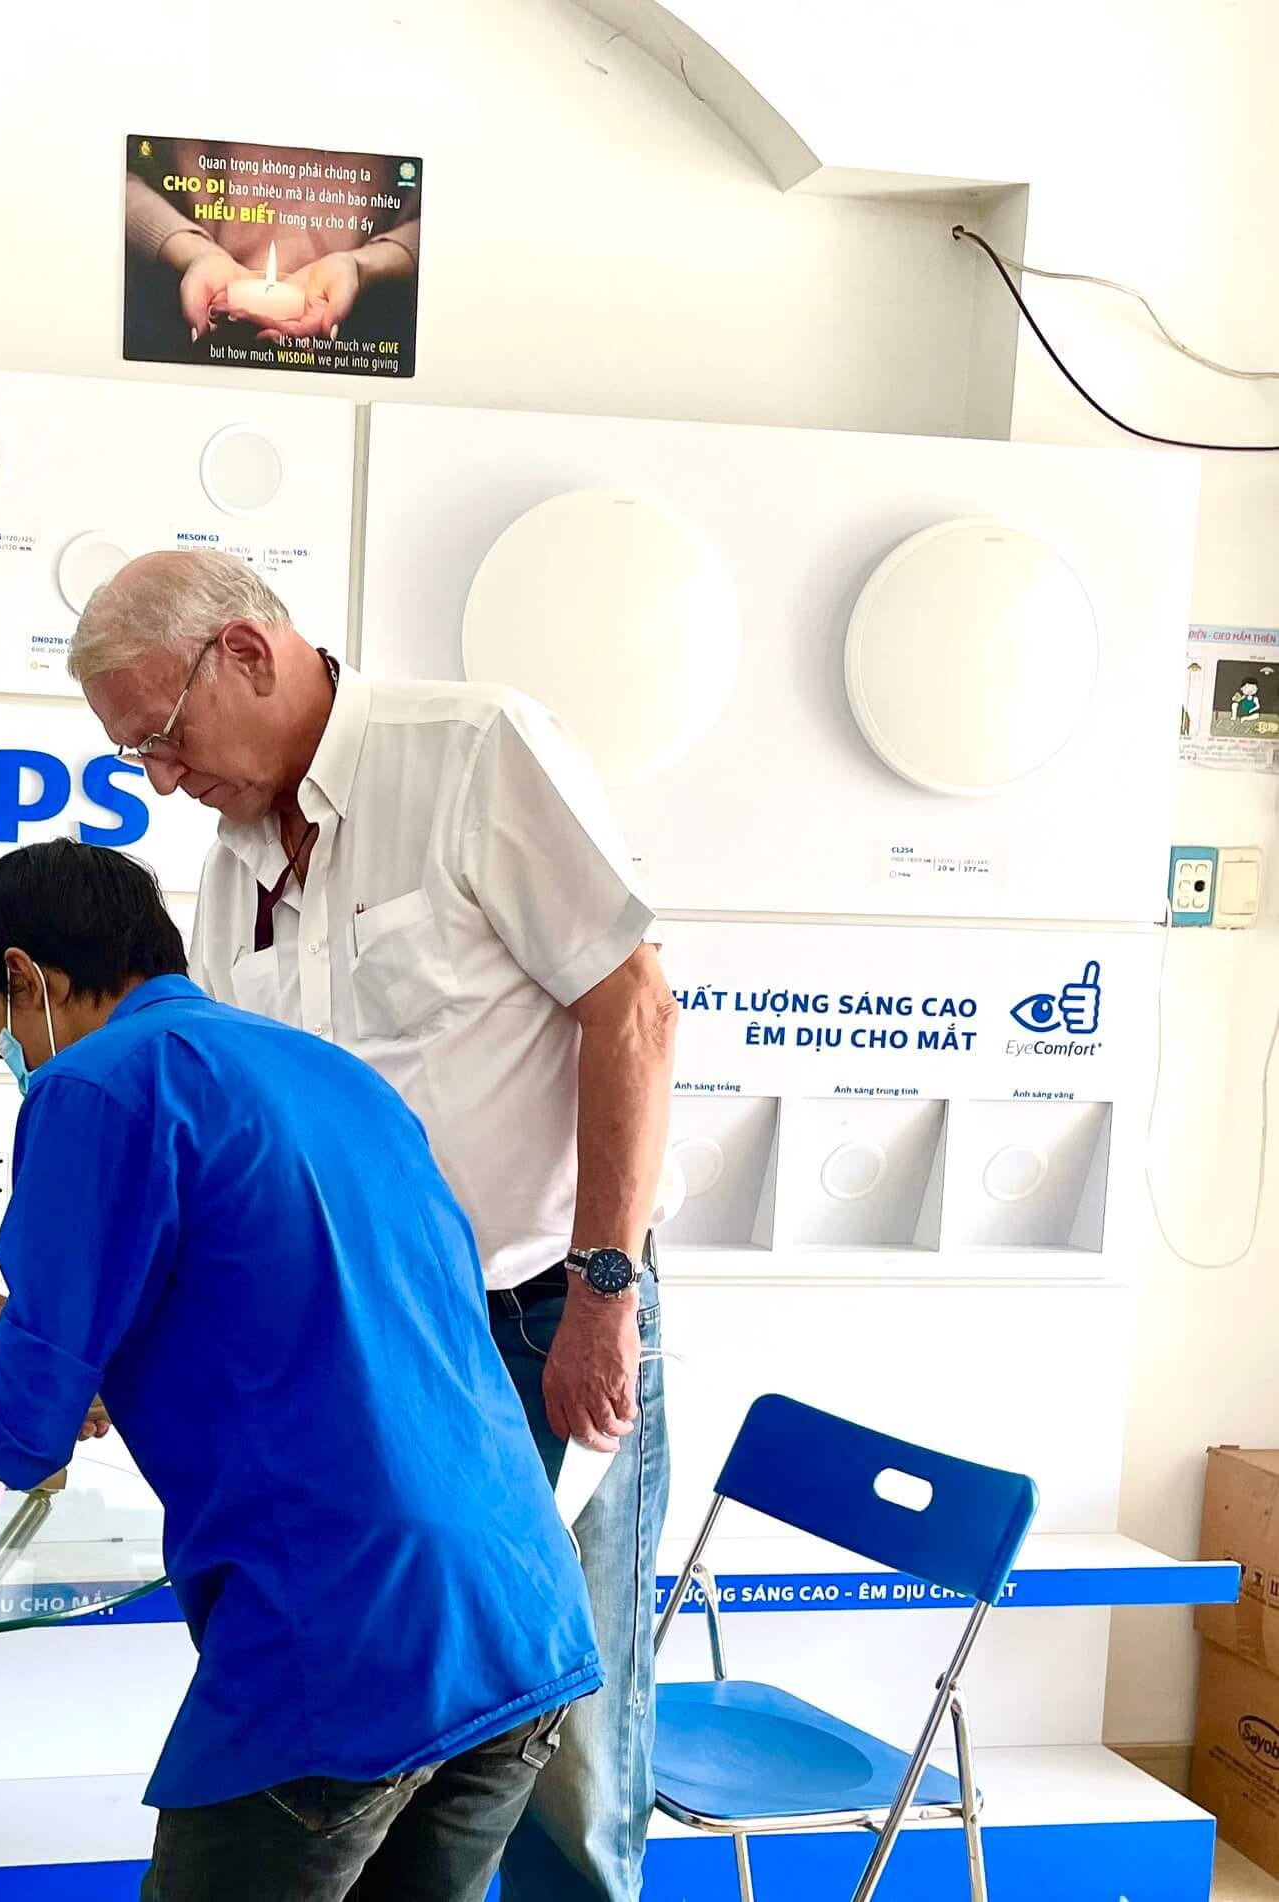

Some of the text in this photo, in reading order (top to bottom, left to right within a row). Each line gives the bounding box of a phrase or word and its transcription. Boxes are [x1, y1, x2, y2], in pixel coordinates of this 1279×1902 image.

[199, 155, 371, 183] Quan trọng không phải chúng ta
[163, 176, 401, 209] CHO ĐI bao nhiêu mà là dành bao nhiêu
[195, 198, 235, 220] HIỂU
[240, 202, 275, 224] BIẾT
[279, 212, 306, 230] trong
[310, 214, 322, 229] sự
[325, 213, 344, 228] cho
[348, 214, 358, 229] đi
[279, 336, 398, 354] It's not how much we GIVE
[210, 344, 398, 372] but how much WISDOM we put into giving
[177, 533, 219, 542] MESON G3
[671, 983, 978, 1018] HẤT LƯỢNG SÁNG CAO
[745, 1021, 978, 1053] ÊM DỊU CHO MẮT
[1006, 1038, 1097, 1057] EyeComfort
[876, 1087, 899, 1096] trung
[741, 1584, 795, 1602] SÁNG
[799, 1586, 839, 1601] CAO
[859, 1582, 887, 1600] ÊM
[893, 1584, 925, 1602] DỊU
[20, 1598, 64, 1612] CHO
